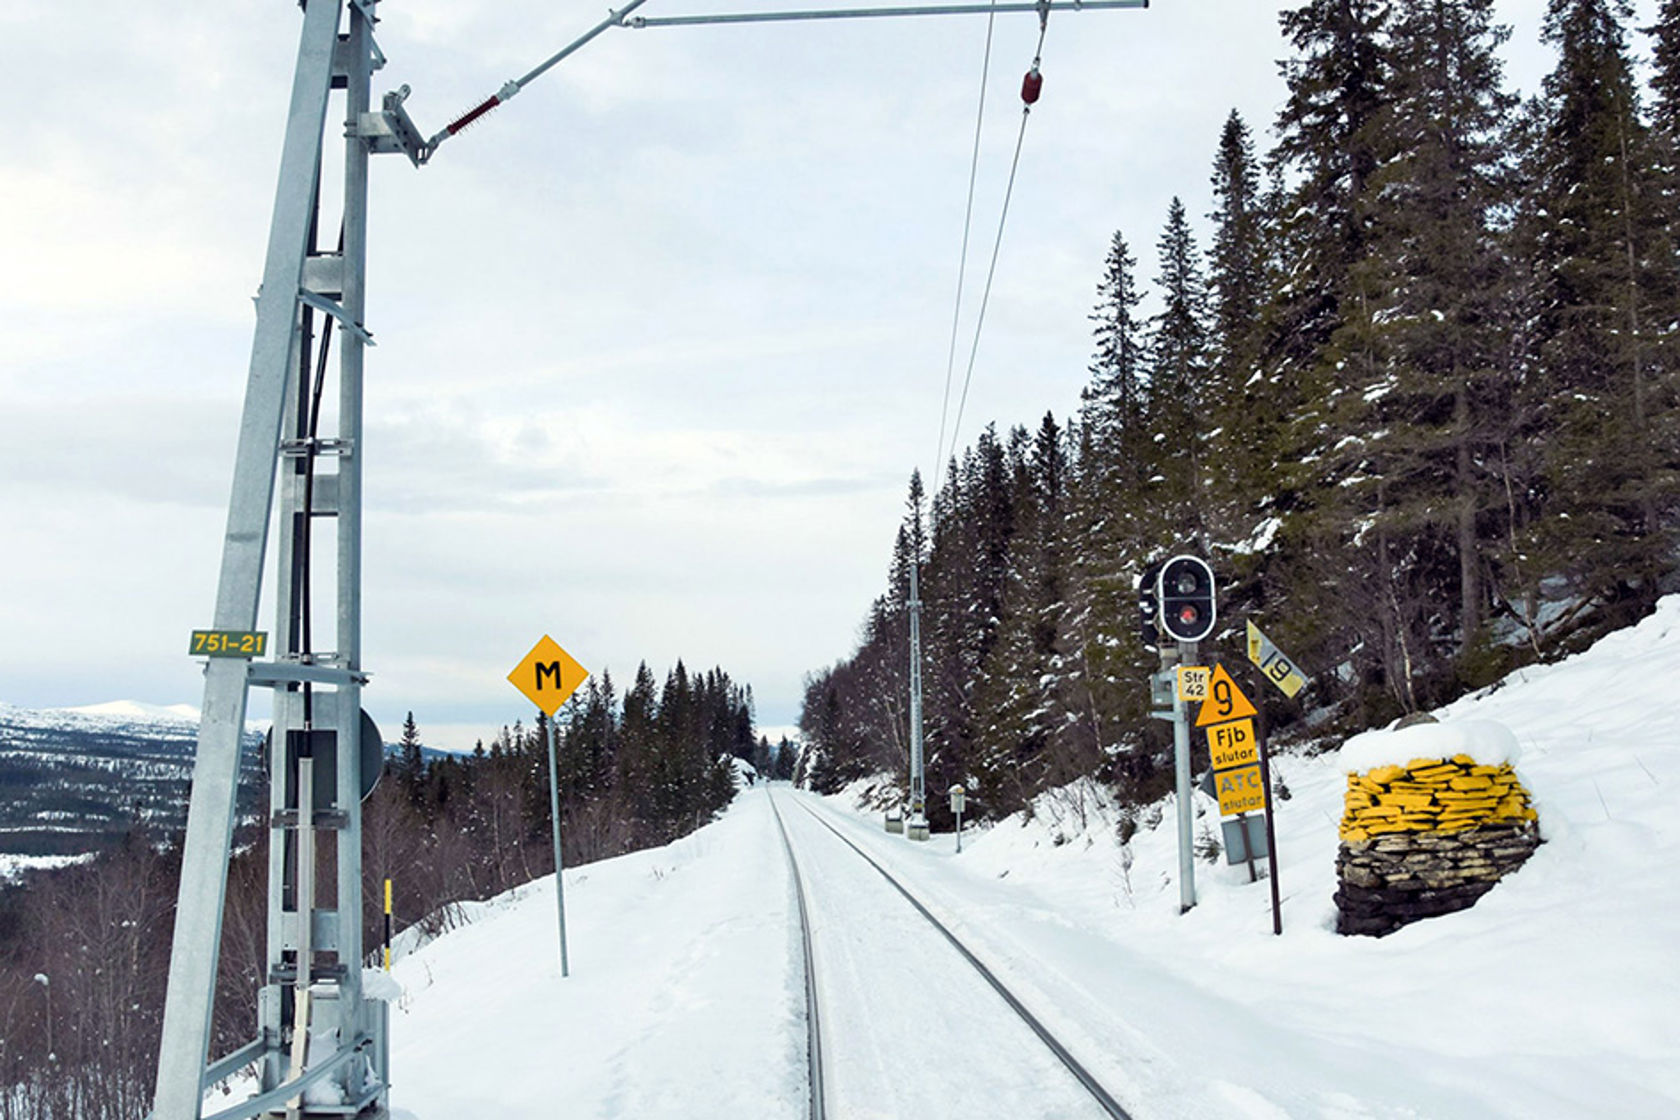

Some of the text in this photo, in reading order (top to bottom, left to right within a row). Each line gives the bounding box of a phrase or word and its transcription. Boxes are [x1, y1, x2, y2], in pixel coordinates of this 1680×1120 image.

[195, 633, 263, 652] 751-21
[535, 661, 561, 690] M
[1184, 671, 1204, 683] Str
[1186, 684, 1204, 696] 42
[1214, 680, 1233, 716] 9
[1216, 727, 1246, 748] Fjb
[1215, 749, 1254, 765] slutar
[1221, 771, 1259, 794] ATC
[1223, 796, 1262, 811] slutar
